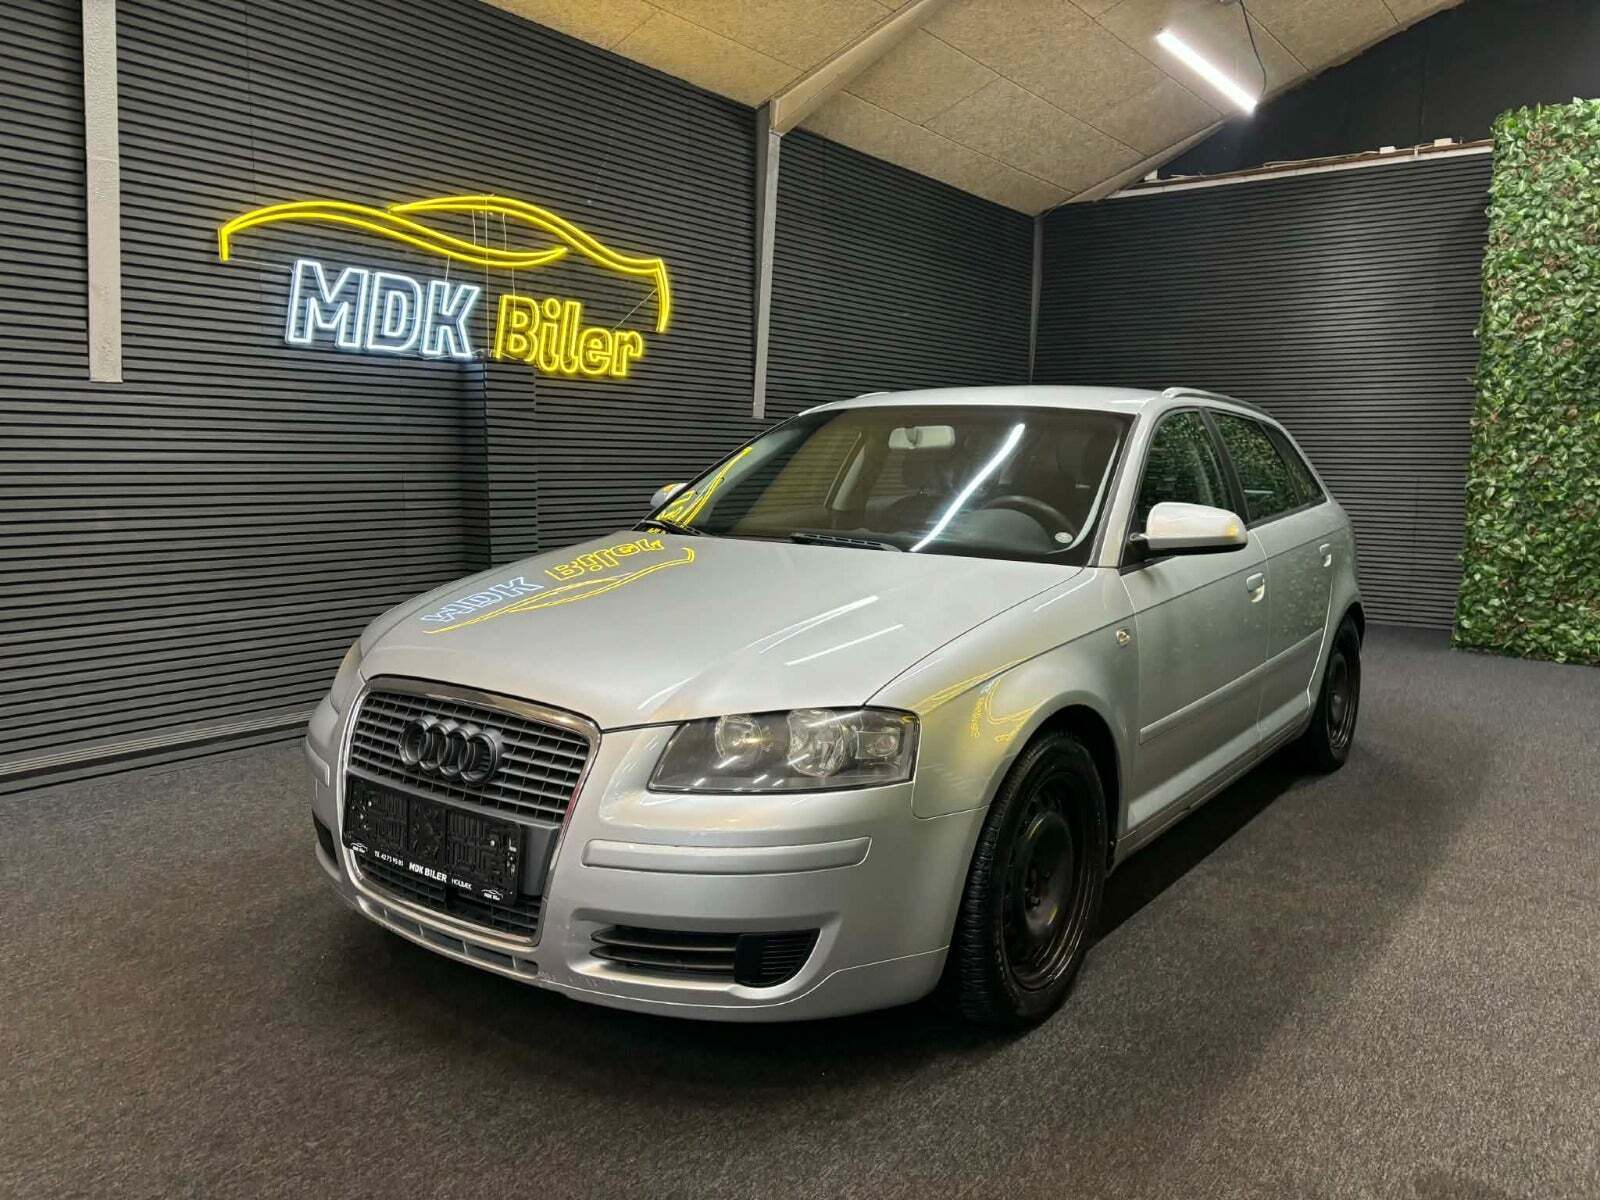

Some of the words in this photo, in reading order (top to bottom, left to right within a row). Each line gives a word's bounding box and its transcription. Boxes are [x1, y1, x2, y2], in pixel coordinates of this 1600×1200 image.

[284, 259, 481, 361] MDK
[492, 294, 644, 377] Biler
[409, 861, 424, 875] MDK
[424, 867, 447, 884] BILER
